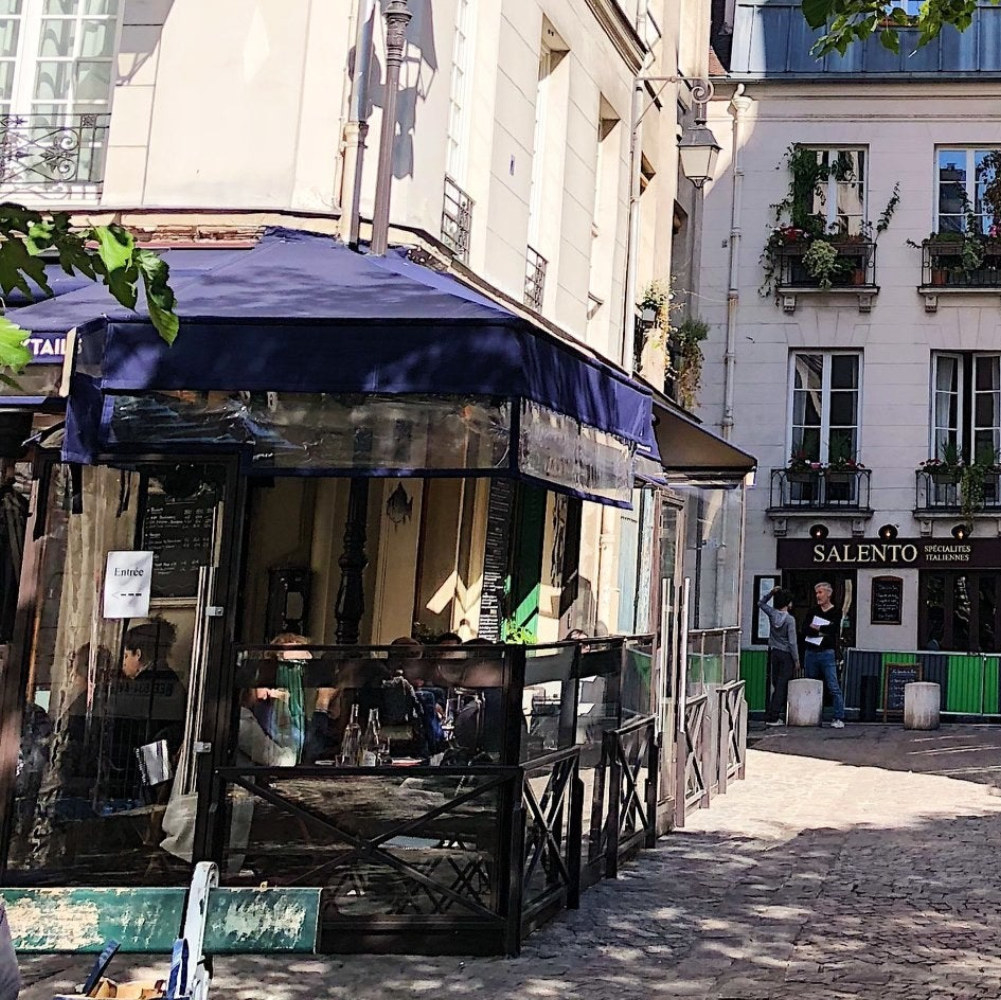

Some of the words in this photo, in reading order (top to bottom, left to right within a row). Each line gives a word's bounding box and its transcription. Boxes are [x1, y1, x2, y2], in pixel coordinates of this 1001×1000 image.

[813, 544, 918, 563] SALENTO
[925, 553, 970, 561] ITALIENNES
[114, 567, 145, 577] Entrée
